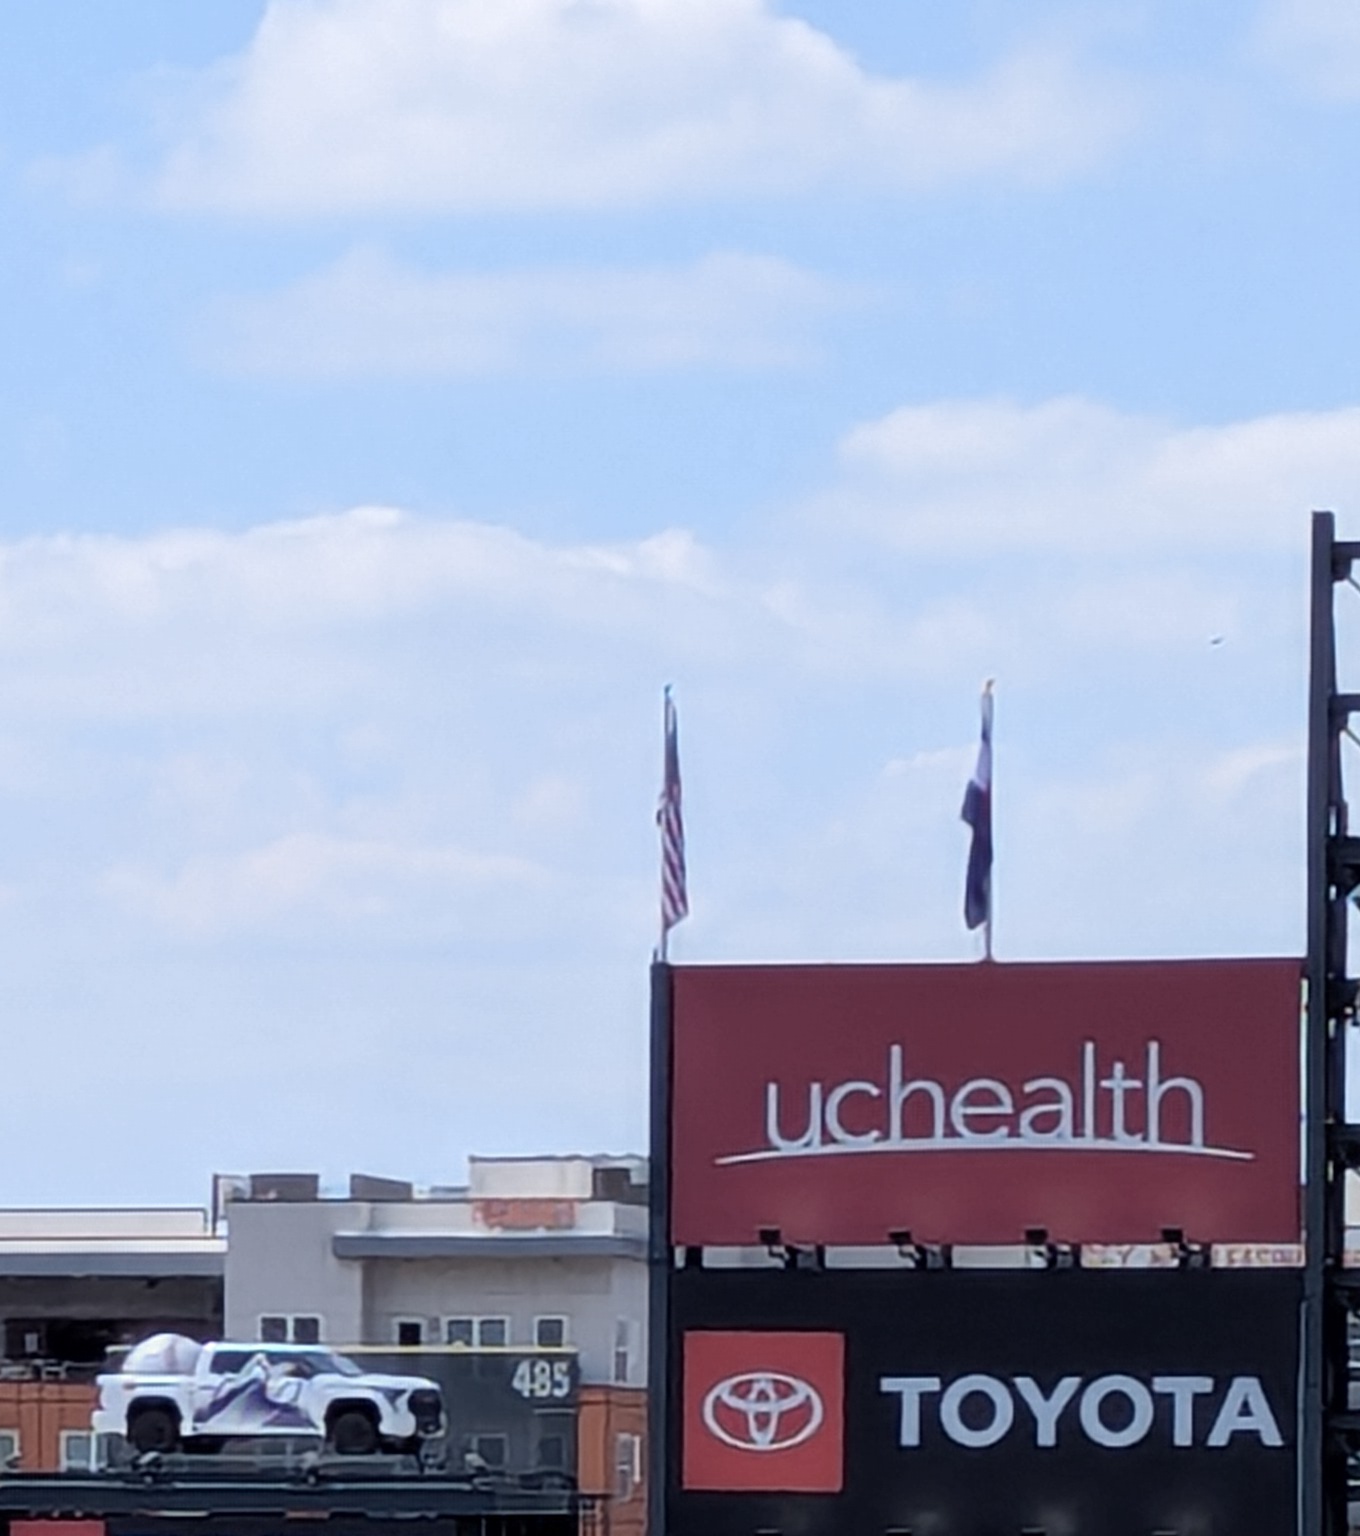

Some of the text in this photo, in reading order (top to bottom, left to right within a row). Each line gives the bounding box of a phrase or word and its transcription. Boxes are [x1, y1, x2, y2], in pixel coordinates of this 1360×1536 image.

[766, 1040, 1204, 1149] uchealth
[511, 1359, 571, 1398] 485
[880, 1374, 1284, 1448] TOYOTA
